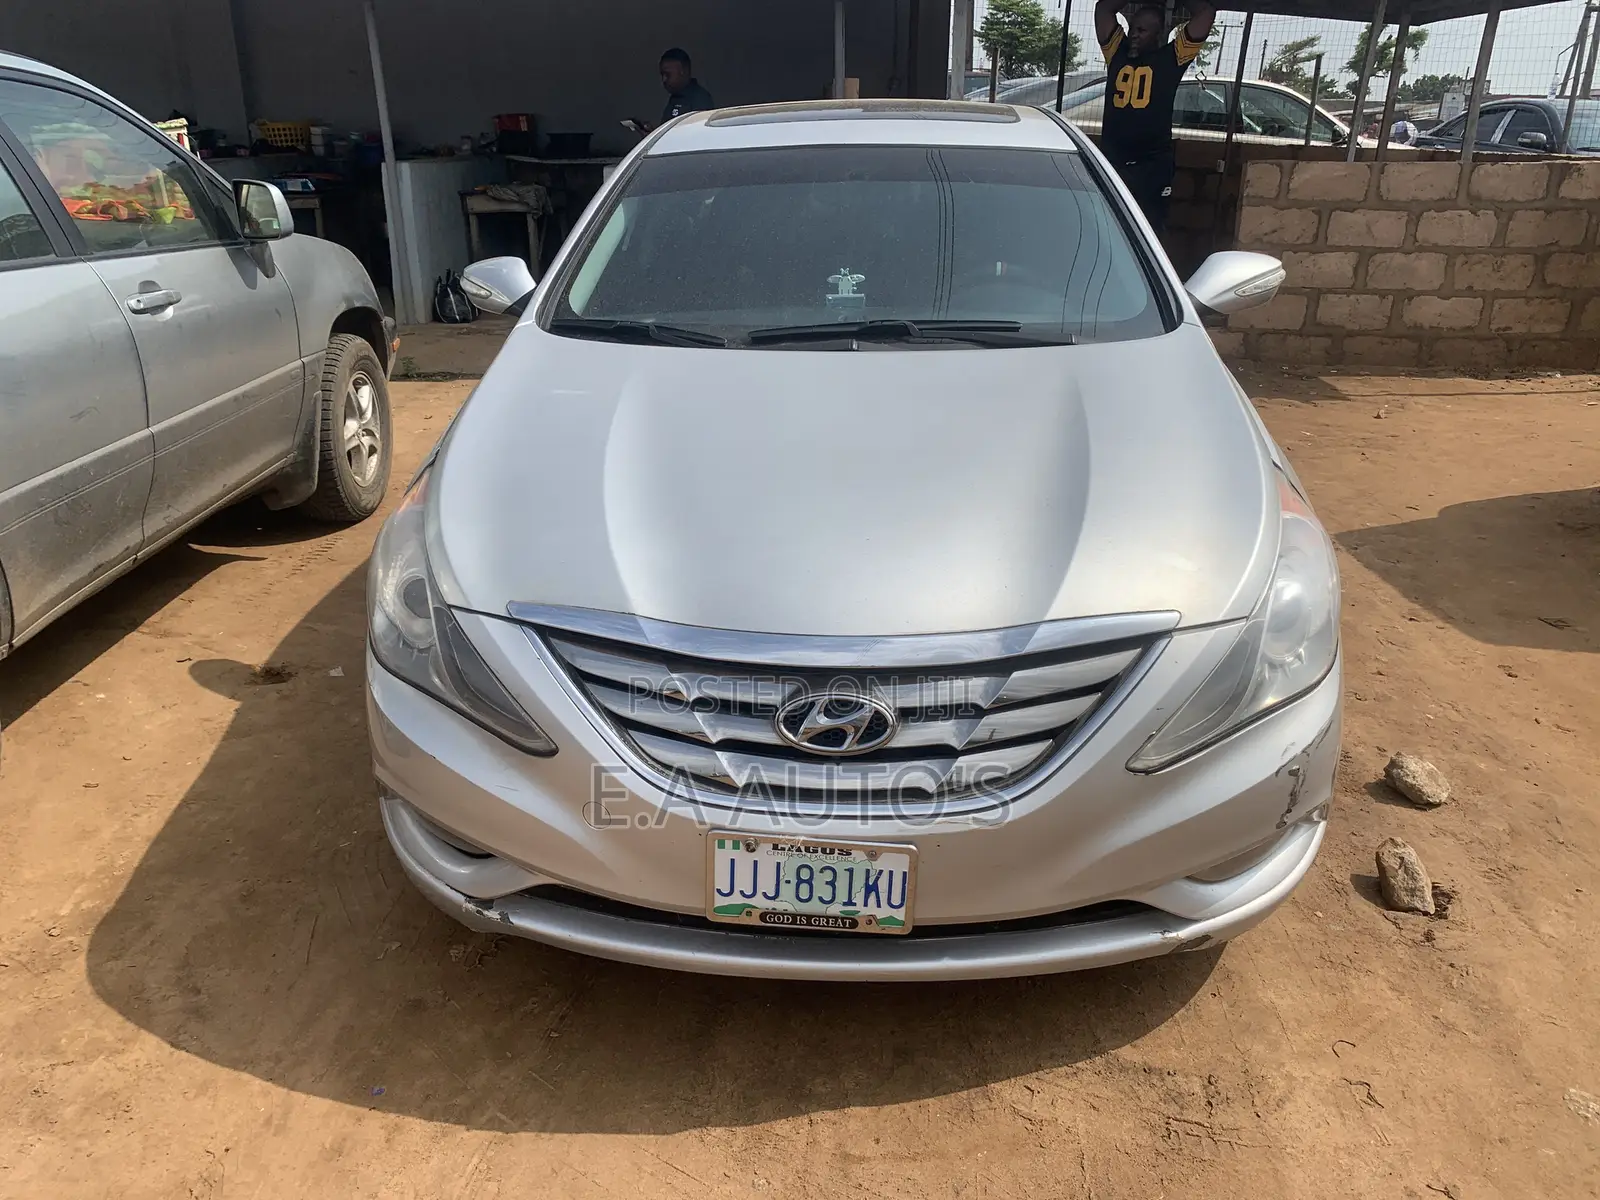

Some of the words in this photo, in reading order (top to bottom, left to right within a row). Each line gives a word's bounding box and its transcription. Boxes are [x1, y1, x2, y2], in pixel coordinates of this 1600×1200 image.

[1113, 65, 1153, 109] 90
[766, 850, 795, 858] CENTRE
[809, 854, 857, 862] EXCELLENCE
[715, 857, 908, 910] JJJ-831KU
[766, 913, 792, 924] GOD
[796, 916, 807, 925] IS
[811, 917, 852, 928] GREAT
